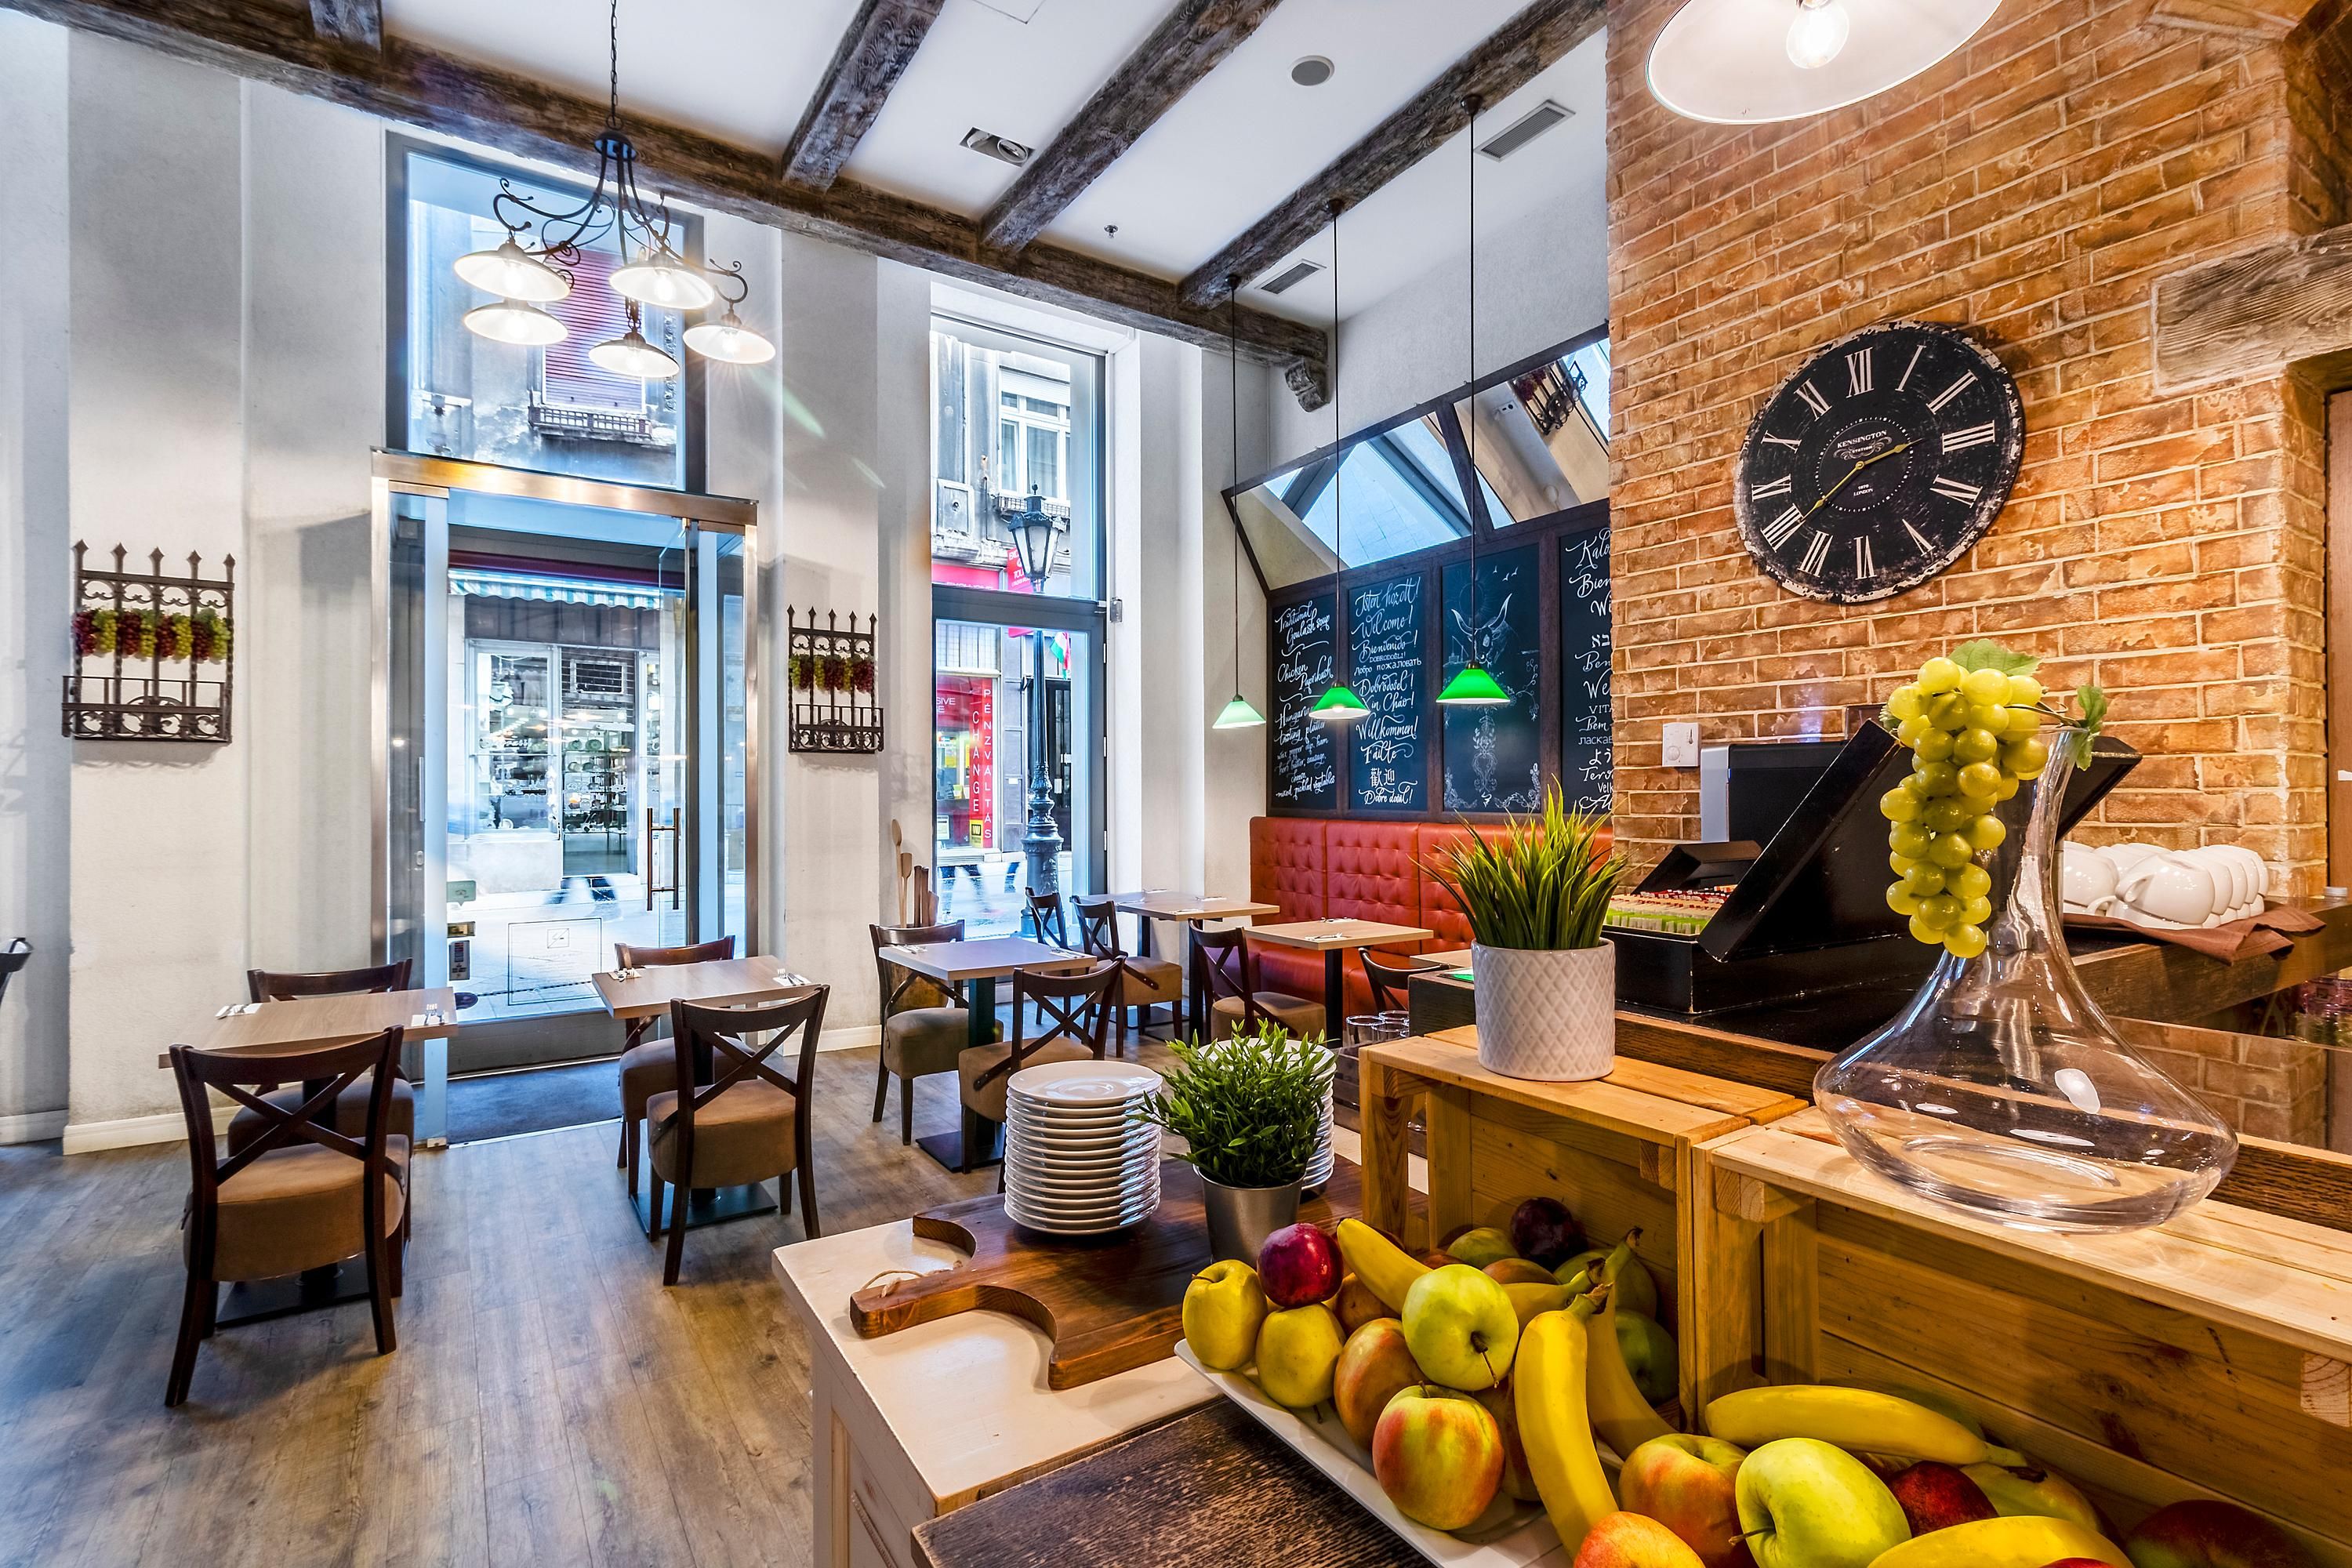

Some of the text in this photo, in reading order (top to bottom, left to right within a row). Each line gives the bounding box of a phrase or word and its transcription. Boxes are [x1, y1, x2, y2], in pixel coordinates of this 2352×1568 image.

[1845, 347, 1874, 398] XII
[1895, 345, 1926, 392] I
[1794, 379, 1832, 421] XI
[1926, 370, 1978, 415] II
[1762, 430, 1802, 453] X
[1837, 430, 1887, 448] KENSINGTON
[1942, 420, 1995, 455] III
[1751, 474, 1791, 502] IX
[1853, 488, 1874, 496] LONDON
[1566, 528, 1610, 570] Kalo
[1275, 601, 1312, 633] Traditional
[1356, 590, 1382, 617] Isten
[1287, 608, 1330, 652] Goulash soup
[1351, 604, 1413, 638] Welcome!
[1278, 652, 1308, 682] Chicken
[1275, 703, 1311, 729] Hungaria
[1588, 704, 1612, 714] VIT
[1274, 725, 1303, 746] tasting
[1356, 713, 1418, 739] Willkommen!
[1313, 765, 1335, 794] vegetables
[1579, 767, 1613, 782] Terv
